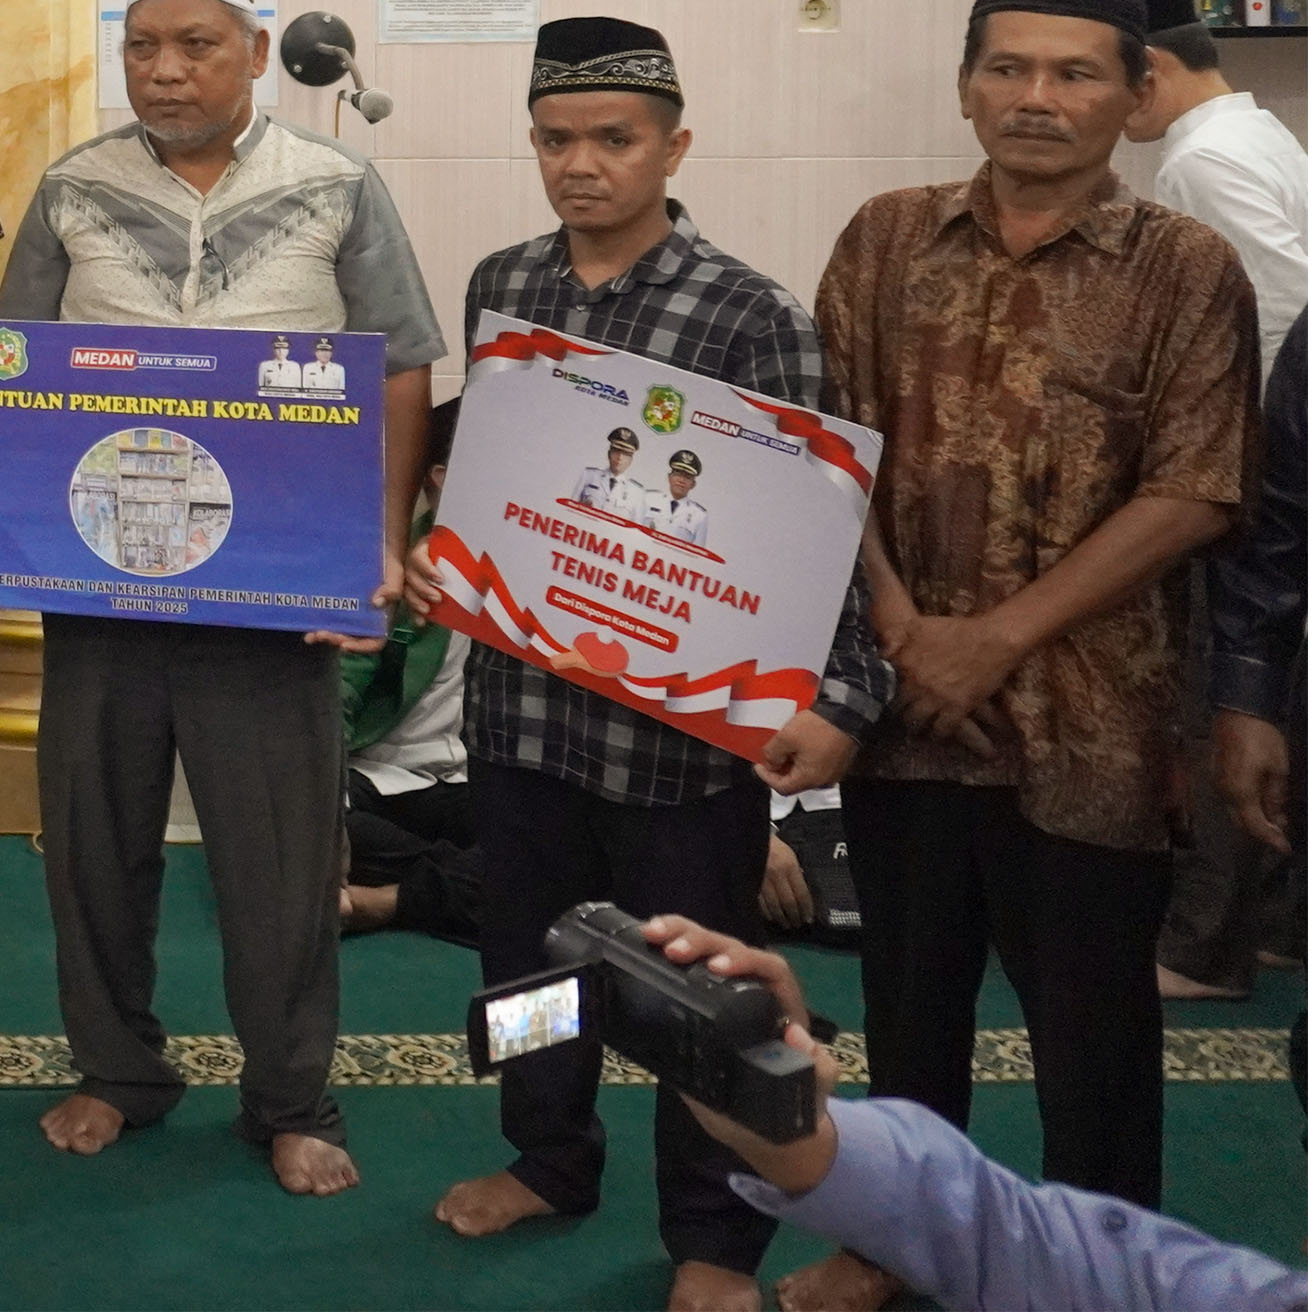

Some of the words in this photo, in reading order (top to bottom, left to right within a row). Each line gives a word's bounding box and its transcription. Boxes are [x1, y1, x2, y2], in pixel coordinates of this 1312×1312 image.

[74, 350, 135, 368] MEDAN
[138, 355, 174, 368] UNTUK
[174, 357, 212, 370] SEMUA
[551, 367, 631, 402] DISPORA
[69, 393, 209, 419] PEMERINTAH
[212, 399, 274, 422] KOTA
[278, 403, 361, 426] MEDAN
[692, 411, 742, 437] MEDAN
[503, 500, 626, 566] PENERIMA
[630, 540, 762, 616] BANTUAN
[88, 579, 114, 594] DAN
[117, 582, 187, 598] KEARSIPAN
[188, 585, 272, 605] PEMERINTAH
[275, 593, 309, 608] KOTA
[311, 594, 360, 611] MEDAN
[549, 549, 619, 594] TENIS
[622, 578, 693, 624] MEJA
[112, 598, 153, 614] TAHUN
[155, 600, 188, 615] 2025
[553, 592, 576, 611] Dari
[575, 599, 612, 625] Dispora
[611, 611, 636, 633] Kota
[635, 621, 671, 647] Medan
